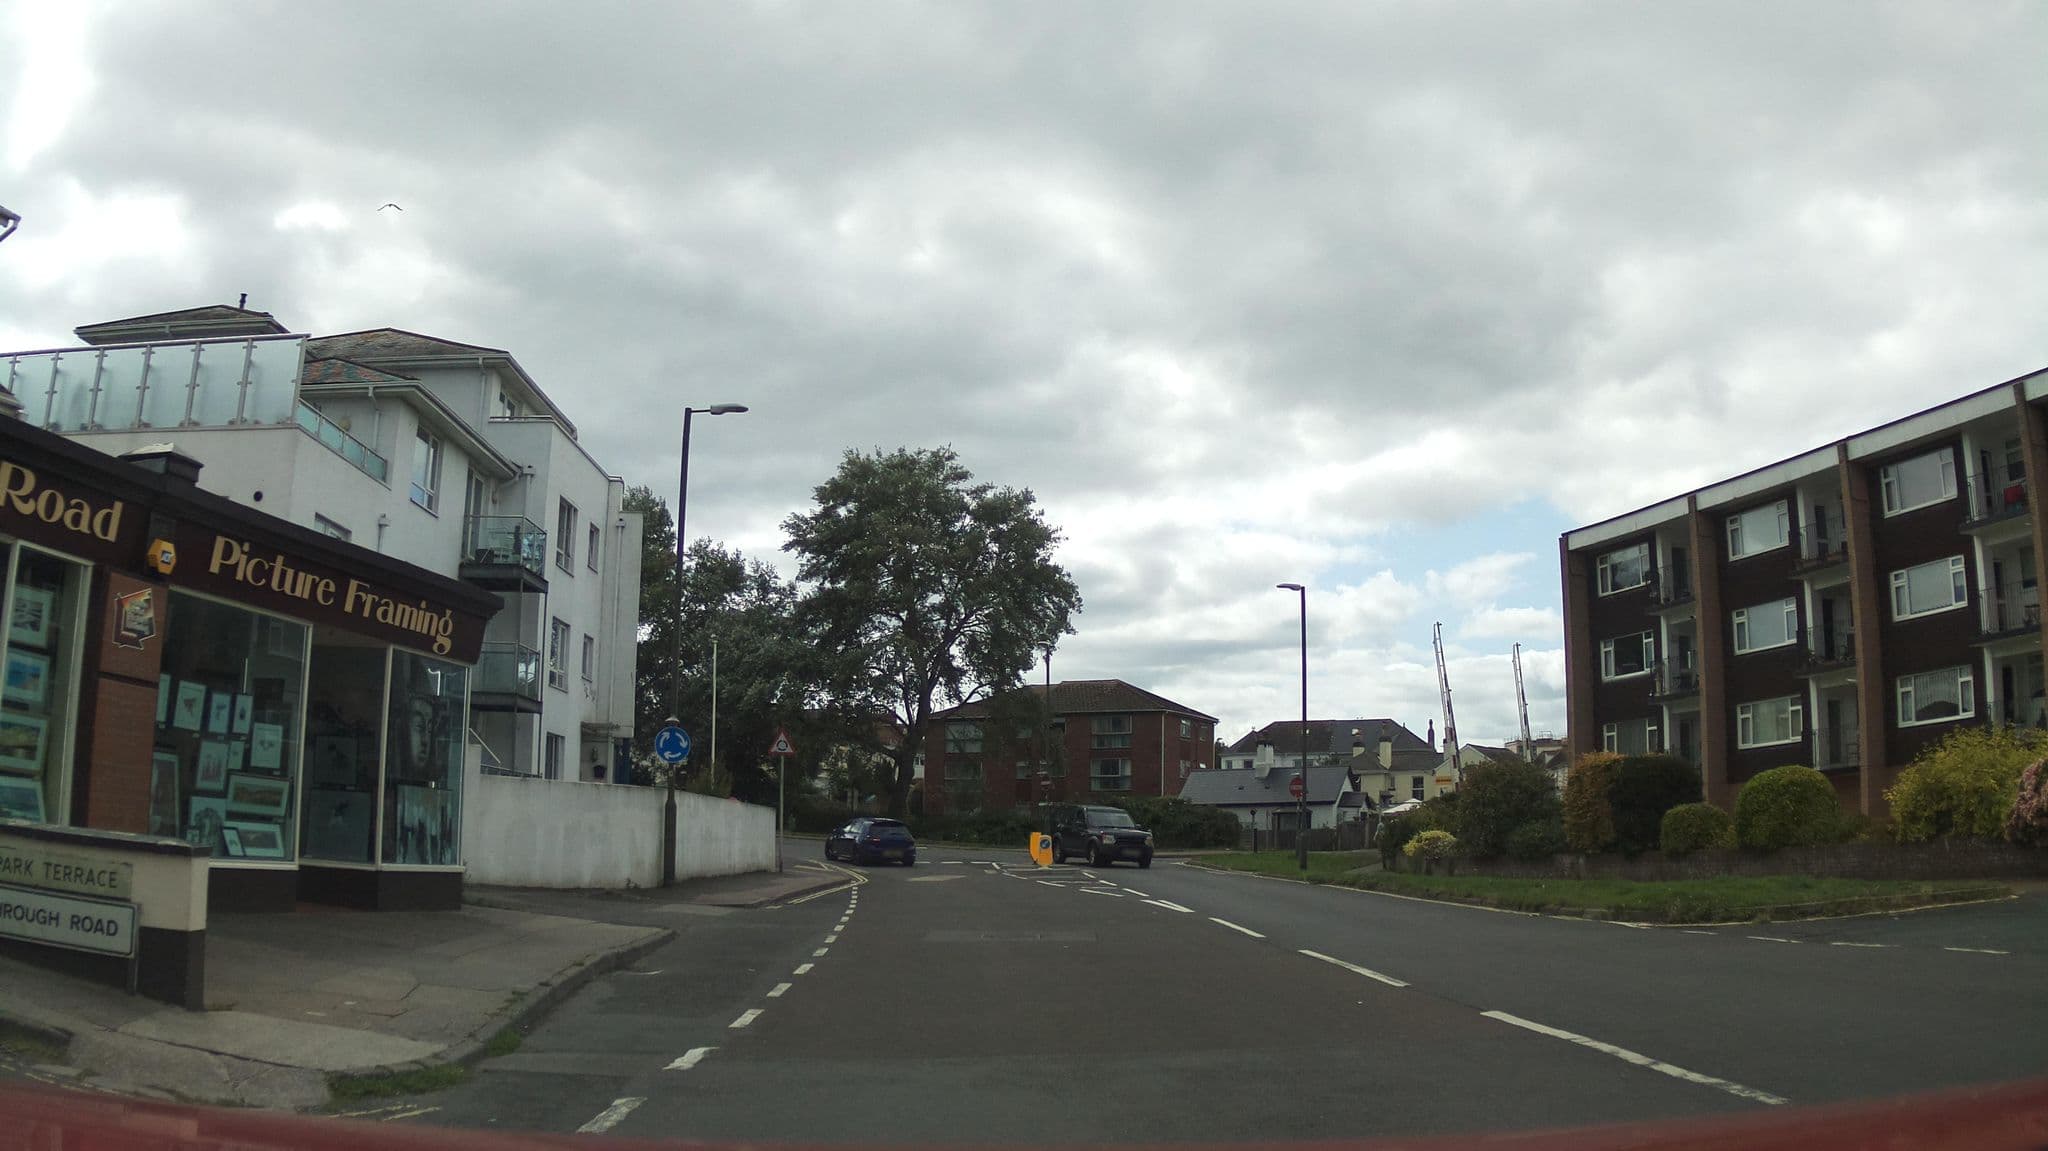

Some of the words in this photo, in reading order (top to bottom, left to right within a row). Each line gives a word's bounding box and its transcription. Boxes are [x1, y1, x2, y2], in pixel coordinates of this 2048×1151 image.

[0, 461, 124, 543] Road
[208, 535, 336, 606] Picture
[344, 579, 454, 655] Framing
[43, 861, 118, 889] TERRACE
[0, 903, 60, 928] ROUGH
[69, 914, 119, 937] ROAD
